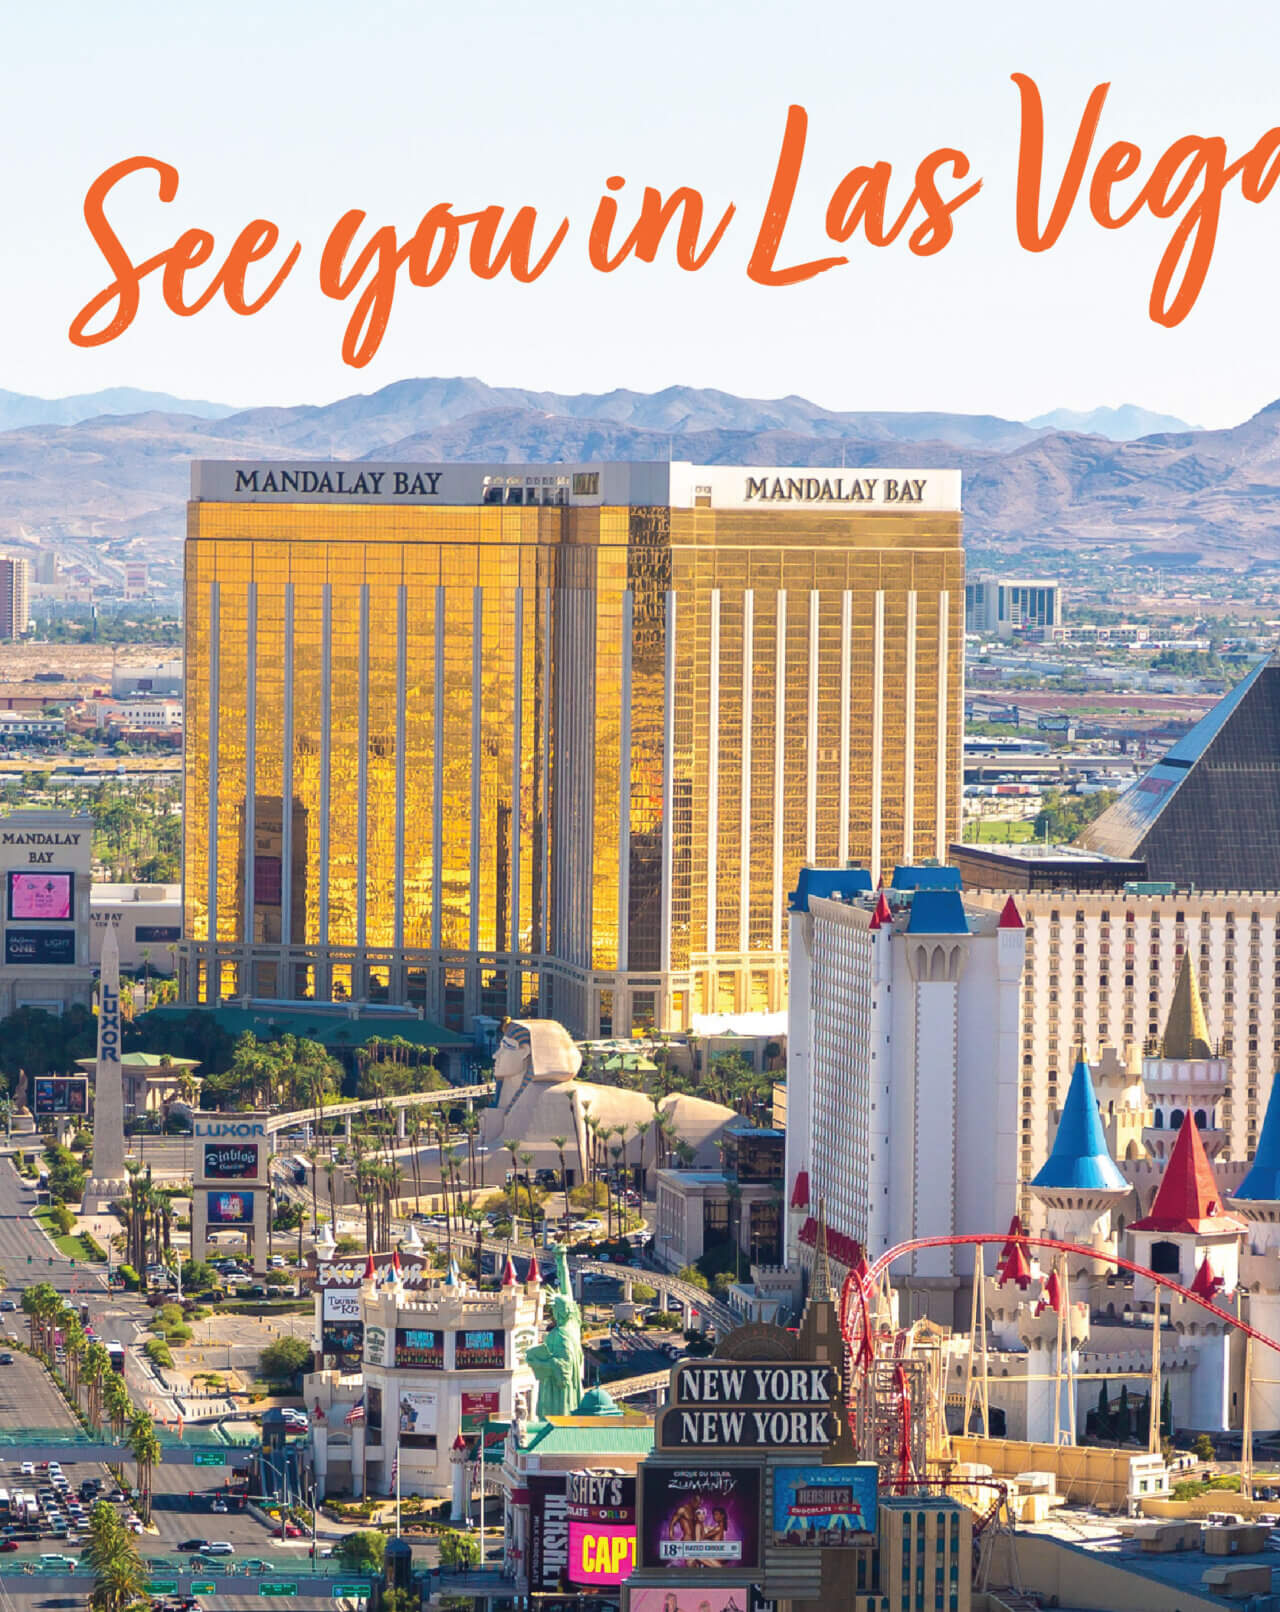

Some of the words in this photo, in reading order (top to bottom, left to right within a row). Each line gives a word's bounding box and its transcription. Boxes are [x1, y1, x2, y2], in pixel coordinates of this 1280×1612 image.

[235, 470, 385, 495] MANDALAY
[392, 472, 442, 495] BAY
[745, 477, 878, 501] MANDALAY
[885, 479, 927, 502] BAY
[2, 833, 81, 845] MANDALAY
[29, 852, 54, 863] BAY
[101, 984, 120, 1062] LUXOR
[195, 1124, 265, 1137] LUXOR
[681, 1369, 746, 1401] NEW
[753, 1369, 830, 1401] YORK
[680, 1411, 746, 1443] NEW
[752, 1411, 830, 1443] YORK
[663, 1543, 682, 1557] 18+
